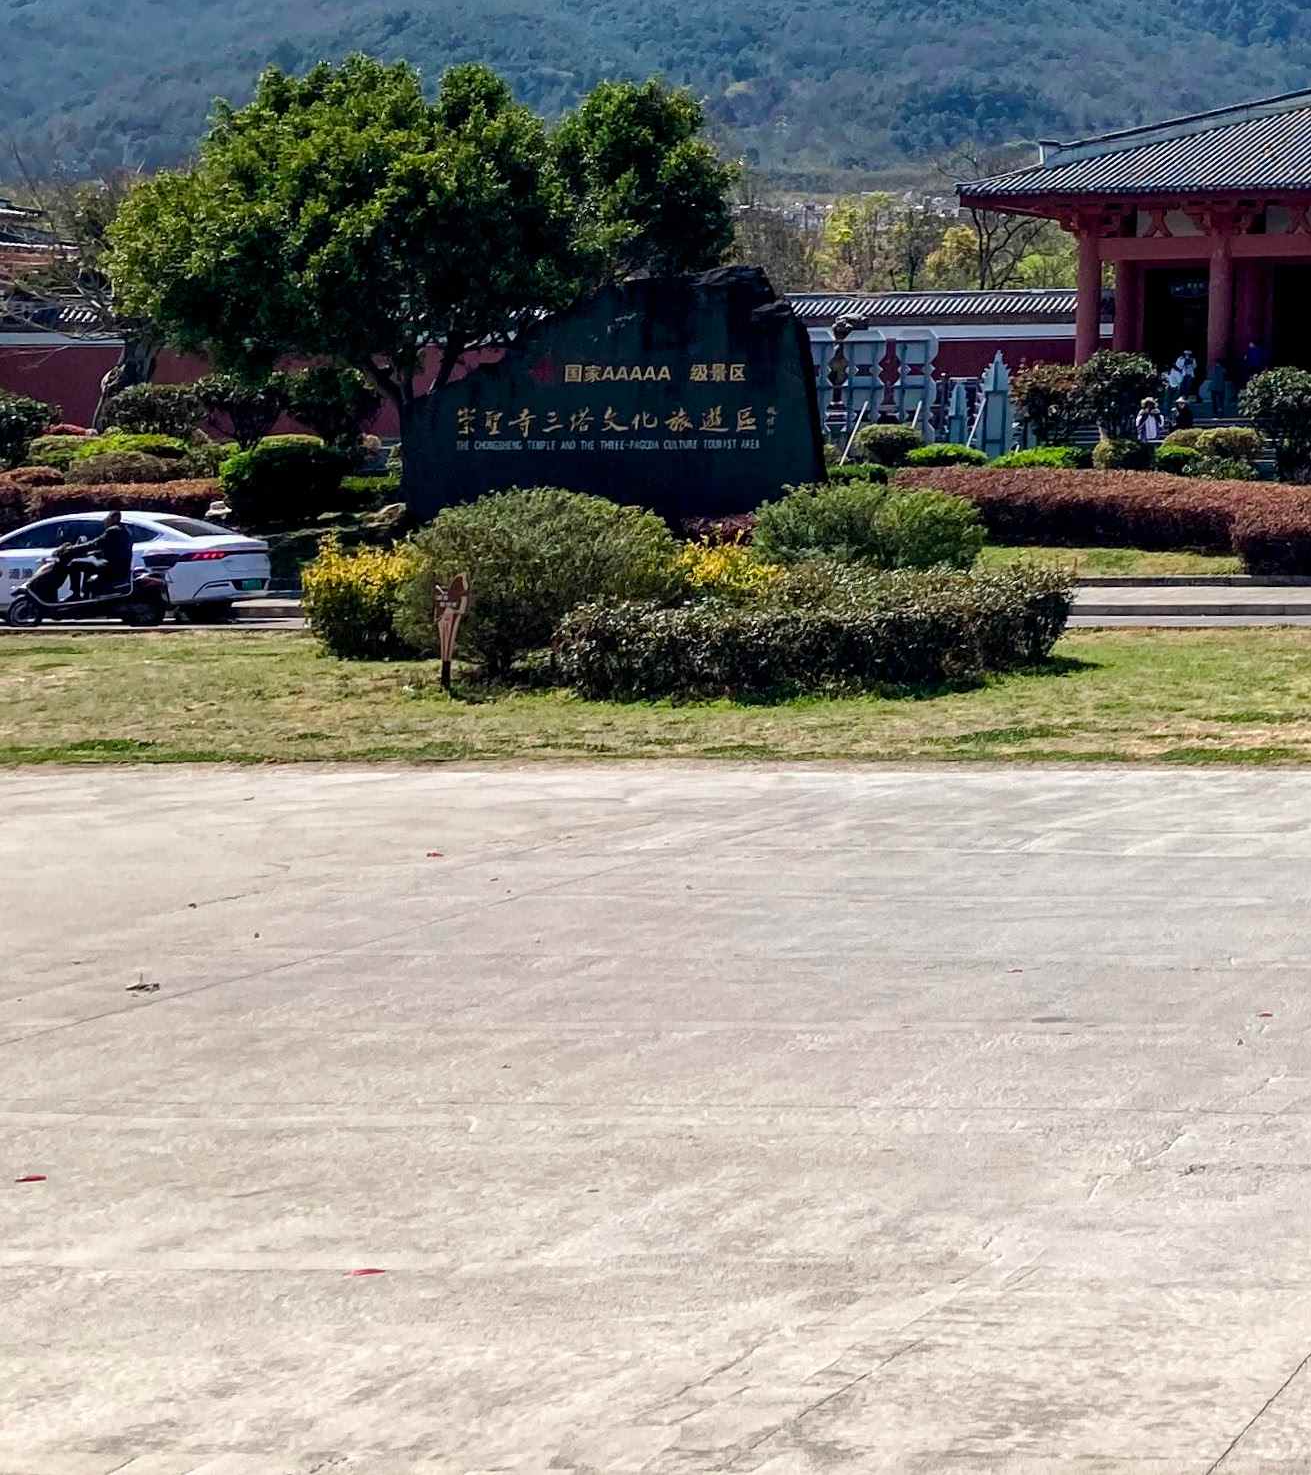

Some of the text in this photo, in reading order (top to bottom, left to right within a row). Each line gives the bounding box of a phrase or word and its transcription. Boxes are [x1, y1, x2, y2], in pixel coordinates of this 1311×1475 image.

[564, 363, 746, 383] 国家AAAAA 级景区
[456, 440, 469, 451] THE
[527, 440, 556, 450] TEMPLE
[560, 440, 576, 450] AND
[581, 440, 595, 450] THE
[663, 439, 698, 450] CULTURE
[704, 439, 736, 450] TOURIST
[740, 439, 760, 450] AREA
